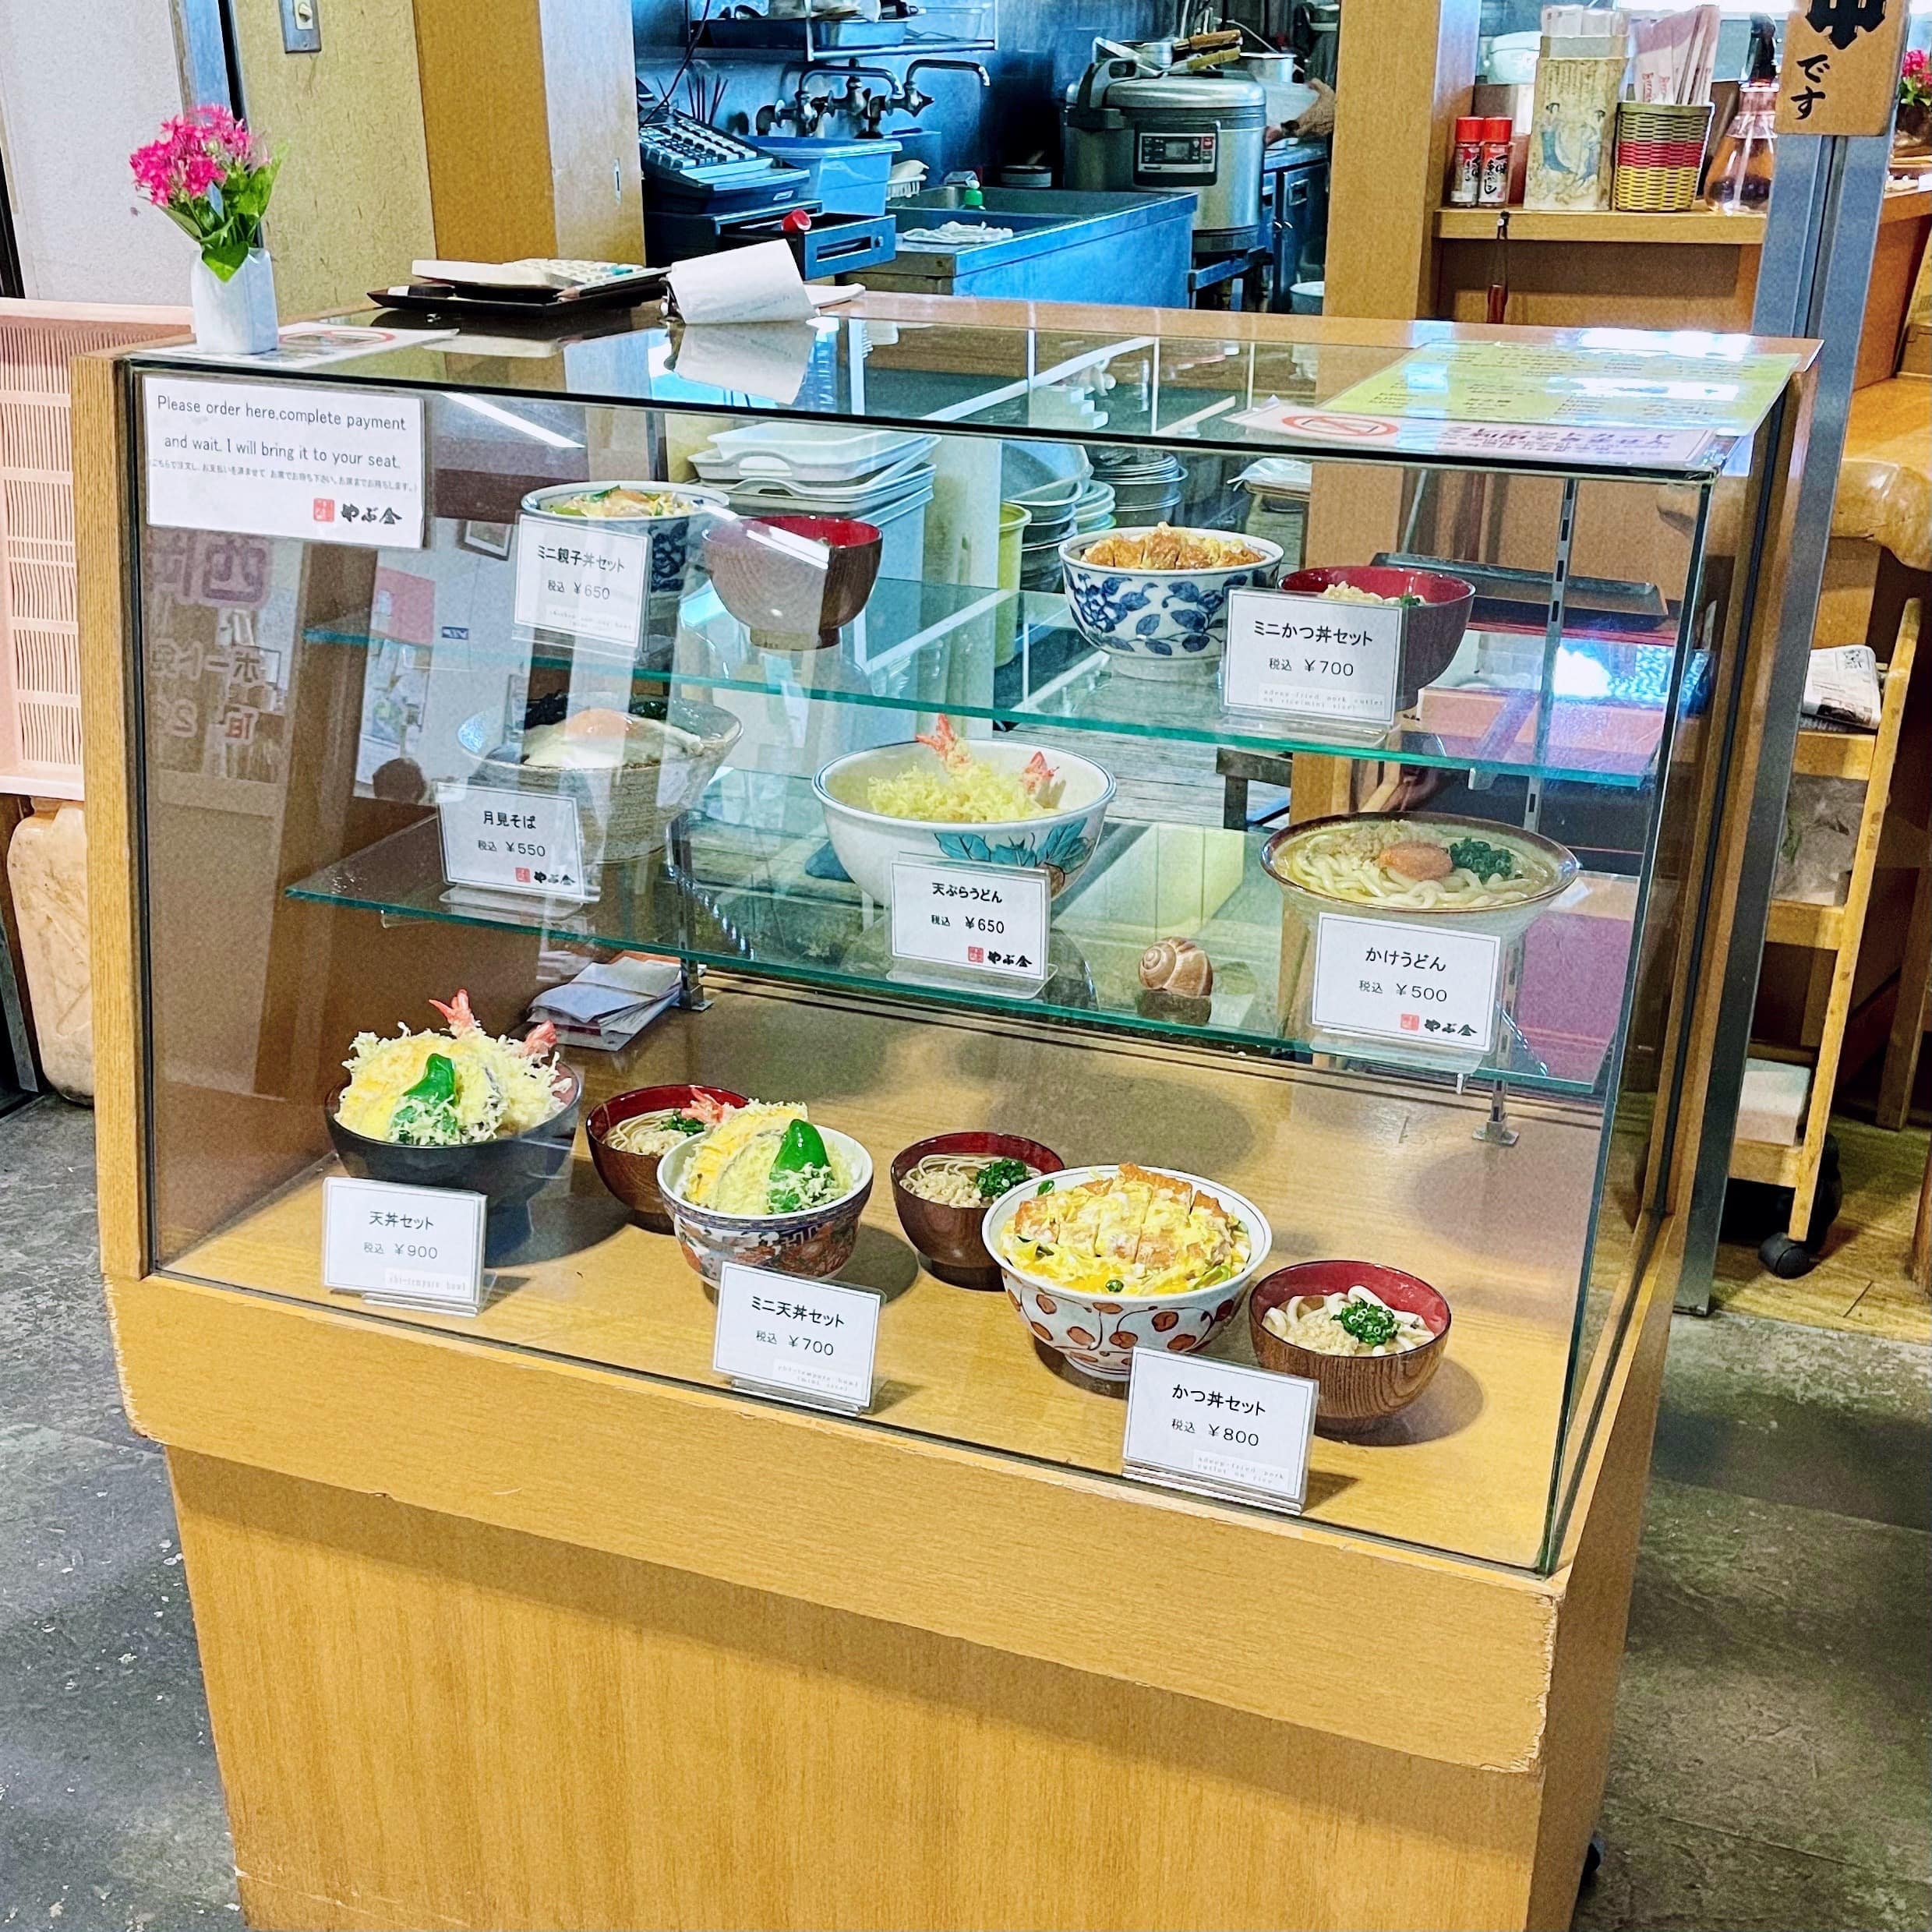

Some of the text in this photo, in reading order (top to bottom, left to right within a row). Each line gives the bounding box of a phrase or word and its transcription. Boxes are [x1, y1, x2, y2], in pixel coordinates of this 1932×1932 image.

[1790, 54, 1831, 120] です
[157, 395, 201, 413] Please
[206, 399, 241, 417] order
[347, 414, 407, 431] payment
[164, 433, 188, 449] and
[192, 436, 222, 452] wait.
[236, 440, 256, 455] will
[261, 441, 295, 462] bring
[299, 444, 309, 460] it
[313, 447, 327, 461] to
[332, 450, 363, 465] your
[368, 454, 401, 469] seat.
[537, 545, 625, 573] ミニ親子丼セット
[547, 579, 565, 592] 税込
[1253, 620, 1373, 647] ミニかつ丼セット
[1269, 658, 1292, 671] 税込
[483, 811, 537, 829] 月見そば
[478, 839, 497, 852] 税込
[932, 881, 1003, 904] 天ぷらうどん
[931, 914, 951, 927] 税込
[1365, 947, 1447, 972] かけうどん
[1358, 980, 1383, 994] 税込
[369, 1211, 434, 1230] 天丼セット
[363, 1241, 385, 1255] 税込
[751, 1296, 845, 1327] ミニ天丼セット
[756, 1330, 777, 1344] 税込
[1171, 1384, 1266, 1416] かつ丼セット
[1171, 1418, 1196, 1434] 税込
